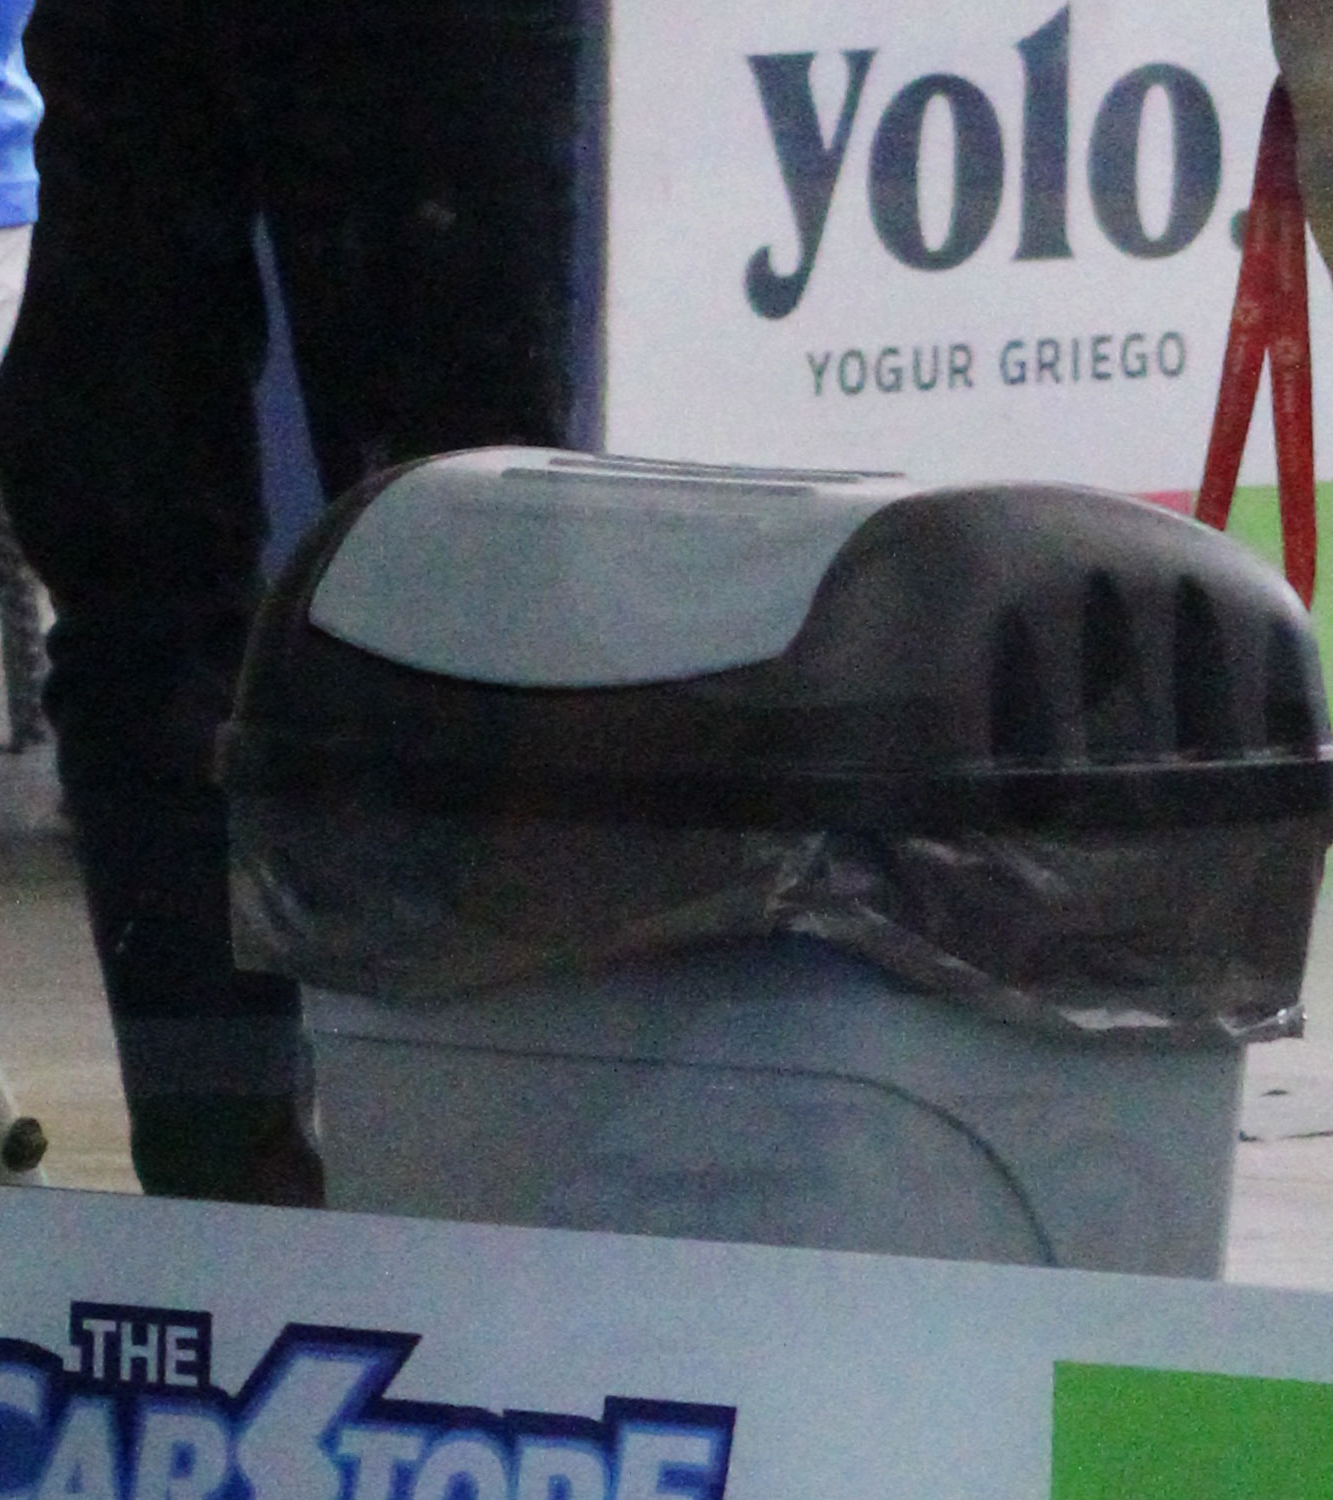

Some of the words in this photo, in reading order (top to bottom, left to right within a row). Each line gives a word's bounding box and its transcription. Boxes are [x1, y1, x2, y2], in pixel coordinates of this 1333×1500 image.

[807, 342, 975, 397] YOGUR
[999, 331, 1188, 385] GRIEGO
[79, 1316, 201, 1388] THE
